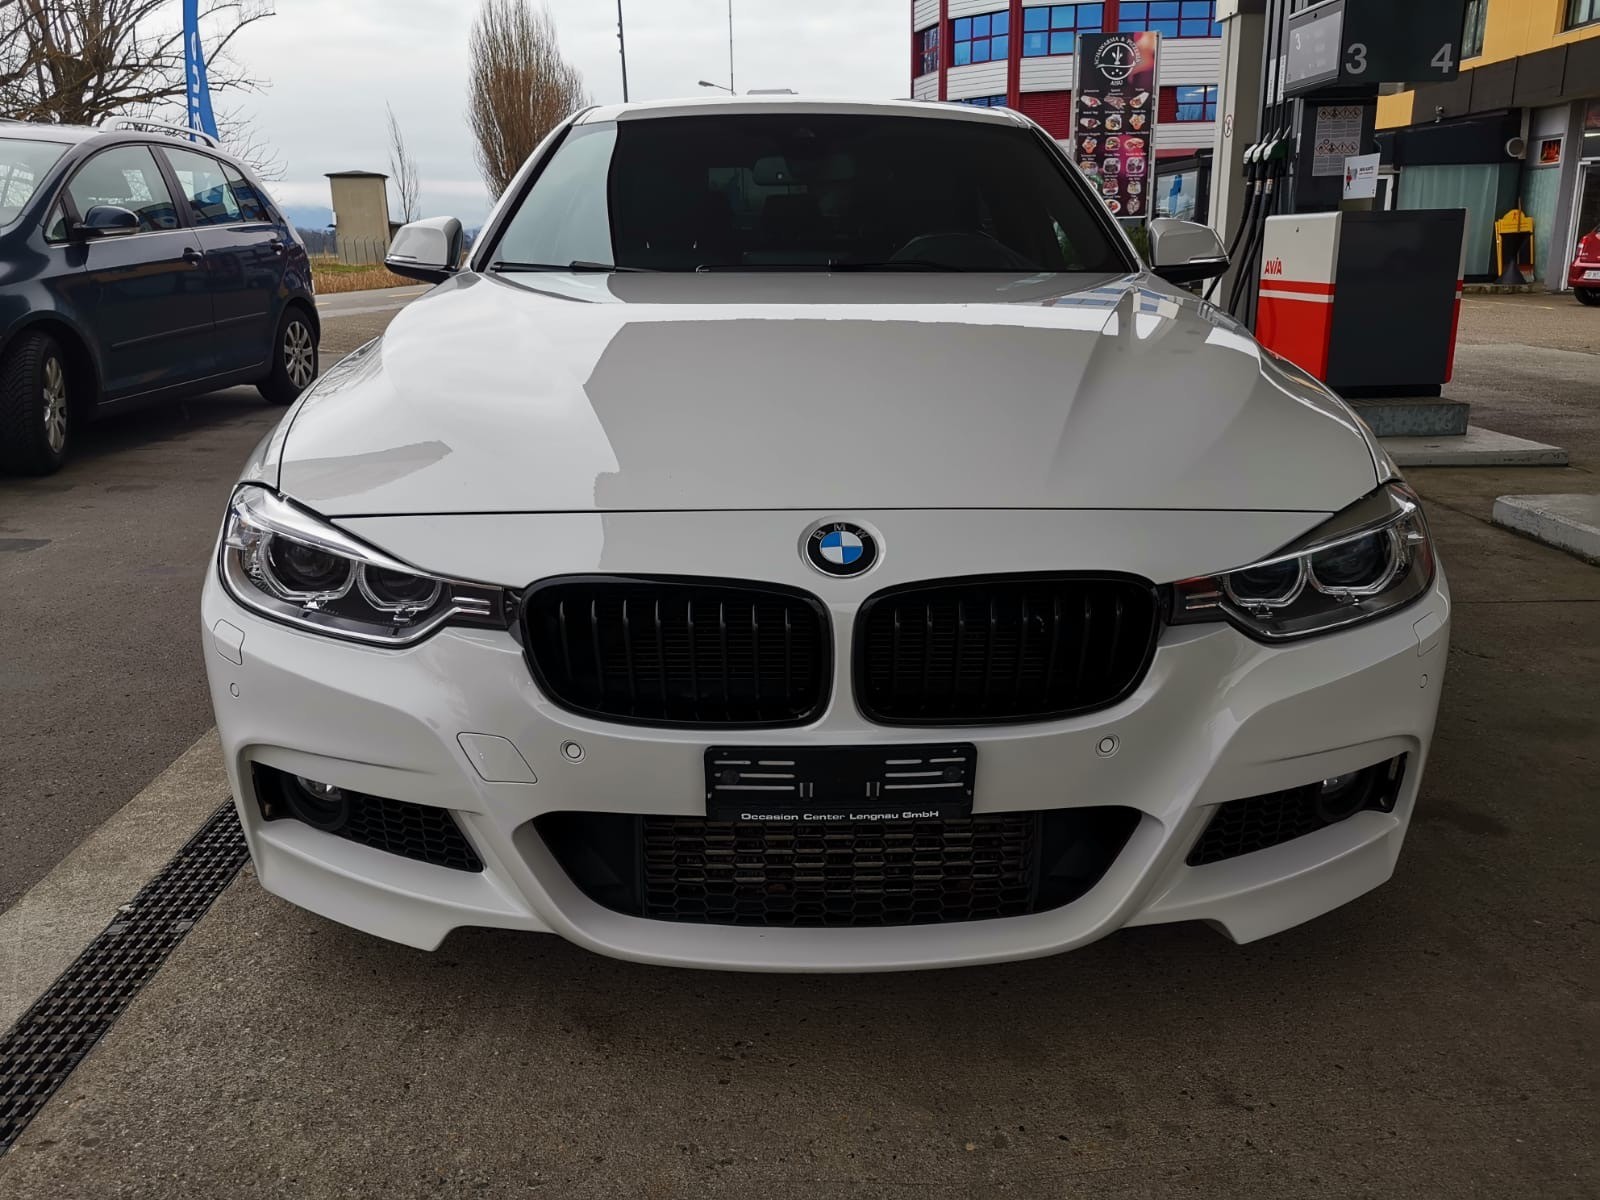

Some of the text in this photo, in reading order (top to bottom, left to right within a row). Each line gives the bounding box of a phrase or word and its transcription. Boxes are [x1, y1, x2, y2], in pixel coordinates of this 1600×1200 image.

[1295, 33, 1302, 51] 3
[1345, 43, 1454, 75] 3 4
[1264, 258, 1283, 275] AVIA
[812, 523, 869, 541] BMW
[740, 811, 940, 822] Occasion Center Lengnau GmbH
